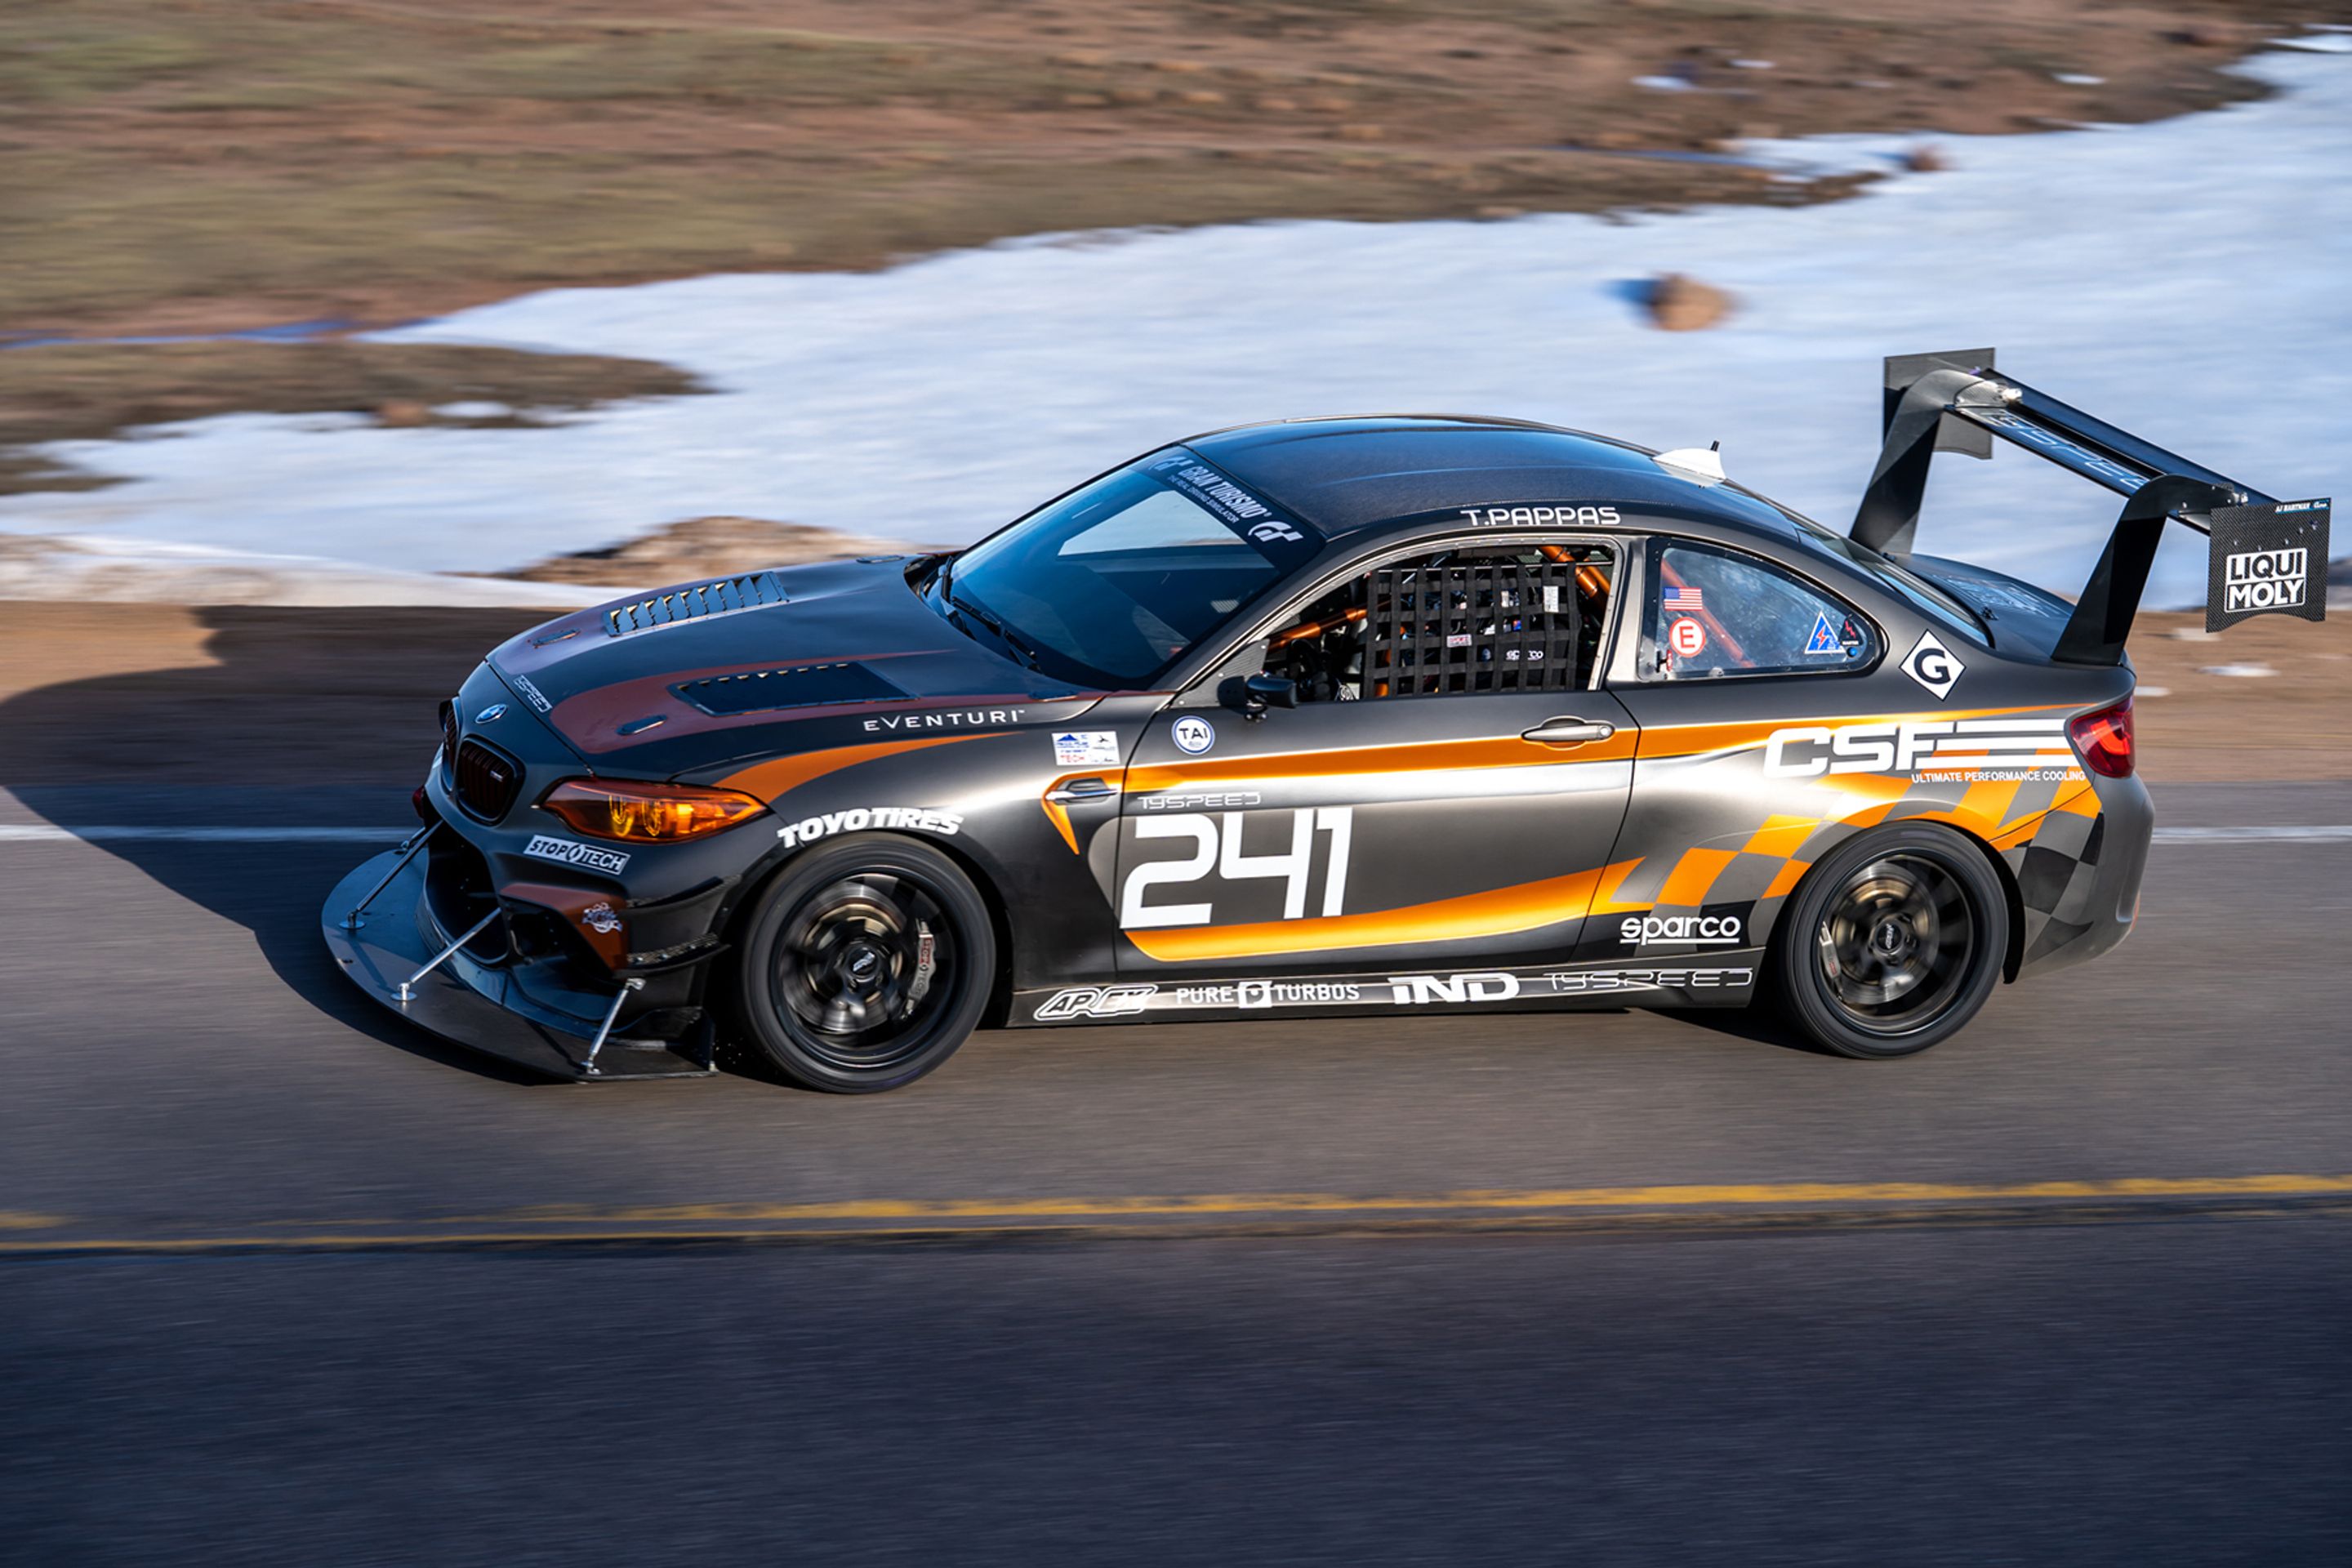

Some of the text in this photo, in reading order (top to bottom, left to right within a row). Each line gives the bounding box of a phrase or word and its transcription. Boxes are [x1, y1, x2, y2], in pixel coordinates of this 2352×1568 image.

[1460, 506, 1621, 527] T.PAPPAS
[2230, 551, 2303, 581] LIQUI
[2229, 579, 2304, 610] MOLY
[1679, 626, 1695, 642] E
[1913, 648, 1951, 685] G
[1178, 728, 1208, 740] TAI
[1763, 721, 1953, 778] CSF
[1911, 770, 2087, 784] ULTIMATE PERFORMANCE COOLING
[1120, 807, 1352, 929] 241
[1620, 915, 1741, 946] sparco
[1176, 983, 1360, 1004] PURE TURBOS
